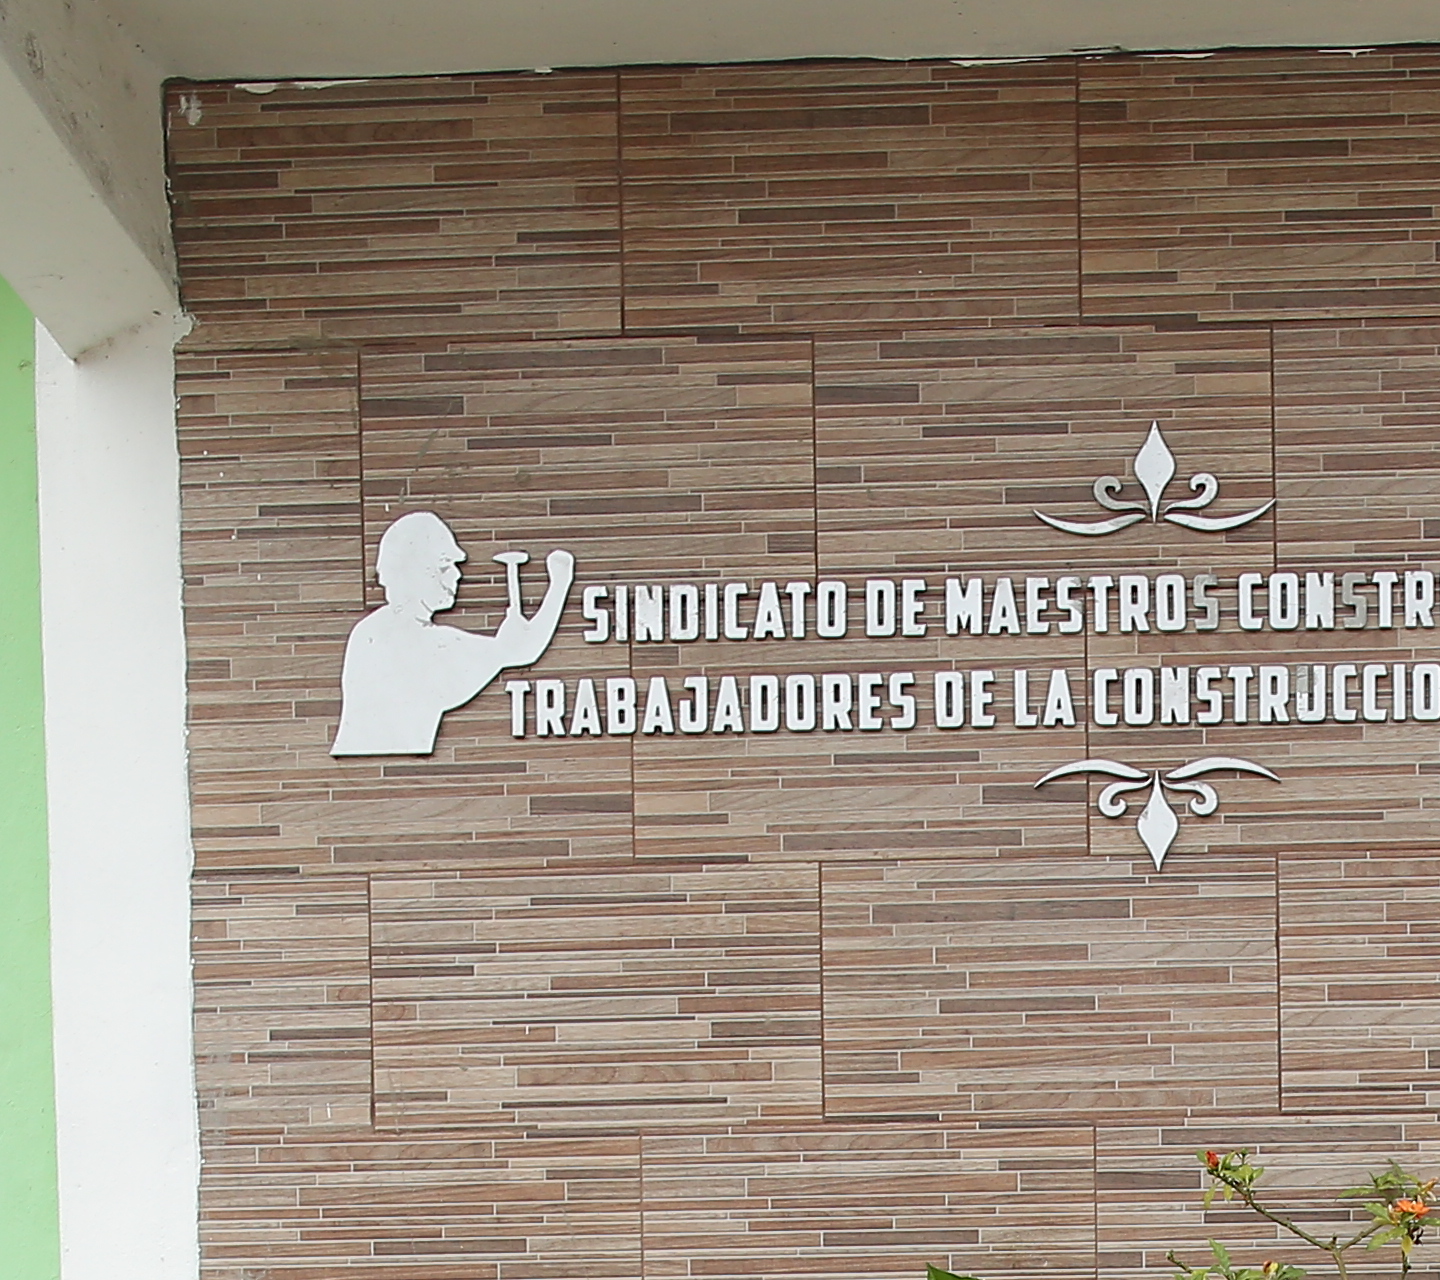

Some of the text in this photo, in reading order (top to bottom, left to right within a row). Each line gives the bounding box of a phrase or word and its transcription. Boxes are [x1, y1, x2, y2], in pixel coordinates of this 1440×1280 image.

[582, 579, 848, 642] SINDICATO
[865, 579, 927, 637] DE
[945, 574, 1219, 636] MAESTROS
[504, 673, 916, 738] TRABAJADORES
[934, 670, 996, 729] DE
[1014, 669, 1076, 727] LA
